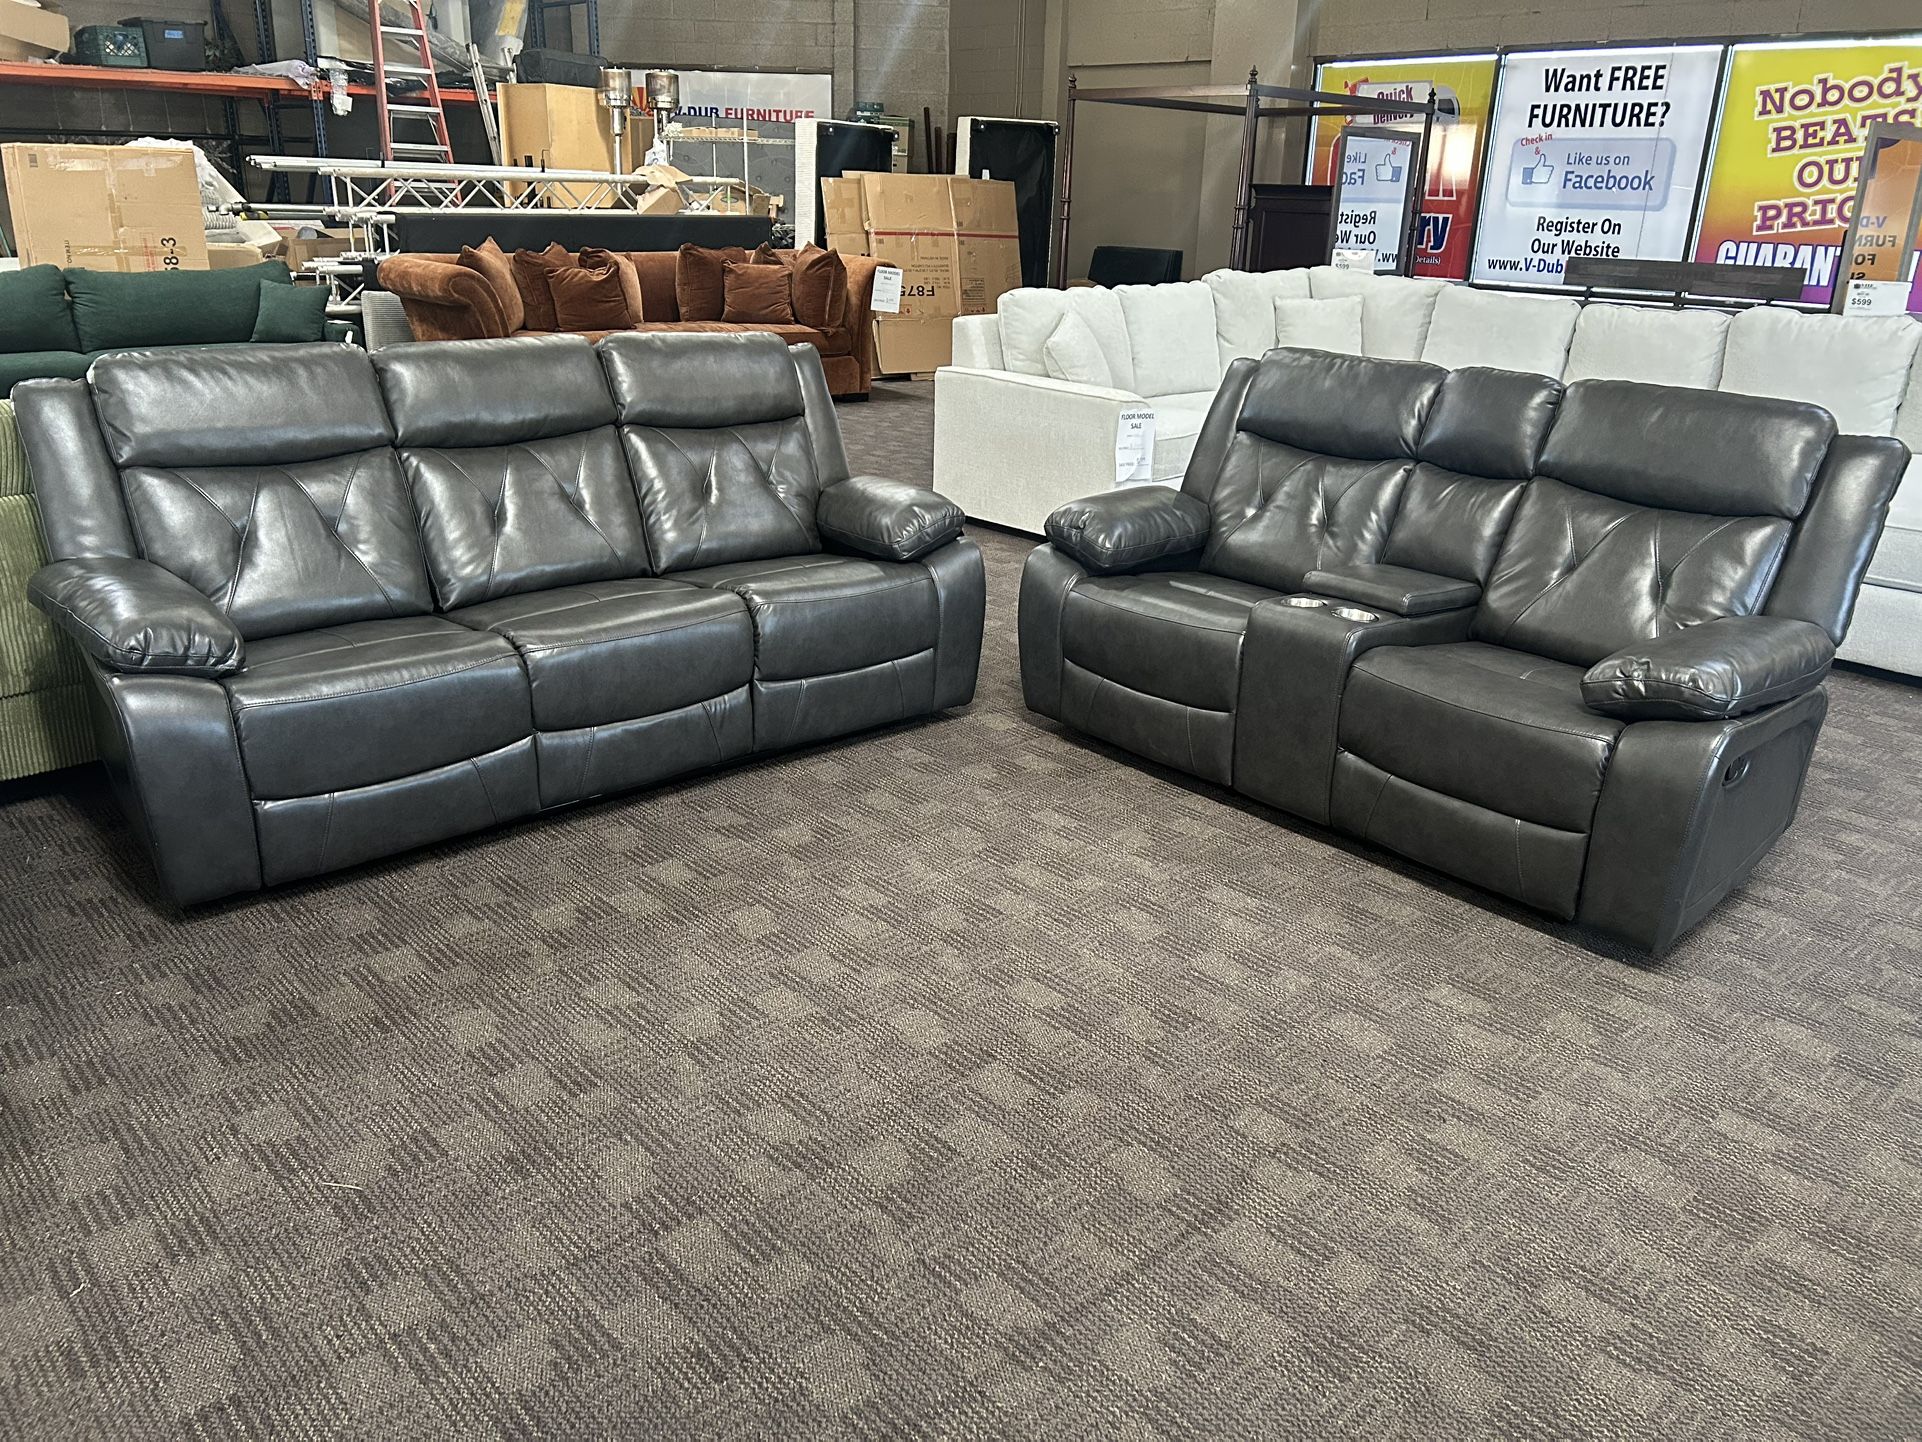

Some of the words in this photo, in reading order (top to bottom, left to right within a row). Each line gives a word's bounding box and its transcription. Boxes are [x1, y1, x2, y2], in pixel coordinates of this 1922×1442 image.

[1544, 67, 1603, 93] Want
[1608, 64, 1667, 92] FREE
[1756, 65, 1922, 118] Nobody
[725, 107, 815, 123] FURNITURE
[1528, 102, 1672, 129] FURNITURE?
[1520, 133, 1544, 147] Check
[1545, 132, 1553, 141] in
[1534, 146, 1541, 156] &
[1566, 152, 1593, 166] Like
[1596, 155, 1611, 166] us
[1614, 154, 1630, 166] on
[1562, 170, 1655, 191] Facebook
[1536, 216, 1598, 237] Register
[1601, 218, 1622, 235] On
[1531, 238, 1557, 254] Our
[1561, 239, 1620, 258] Website
[1716, 239, 1841, 286] GUARAN
[1851, 297, 1872, 306] $599
